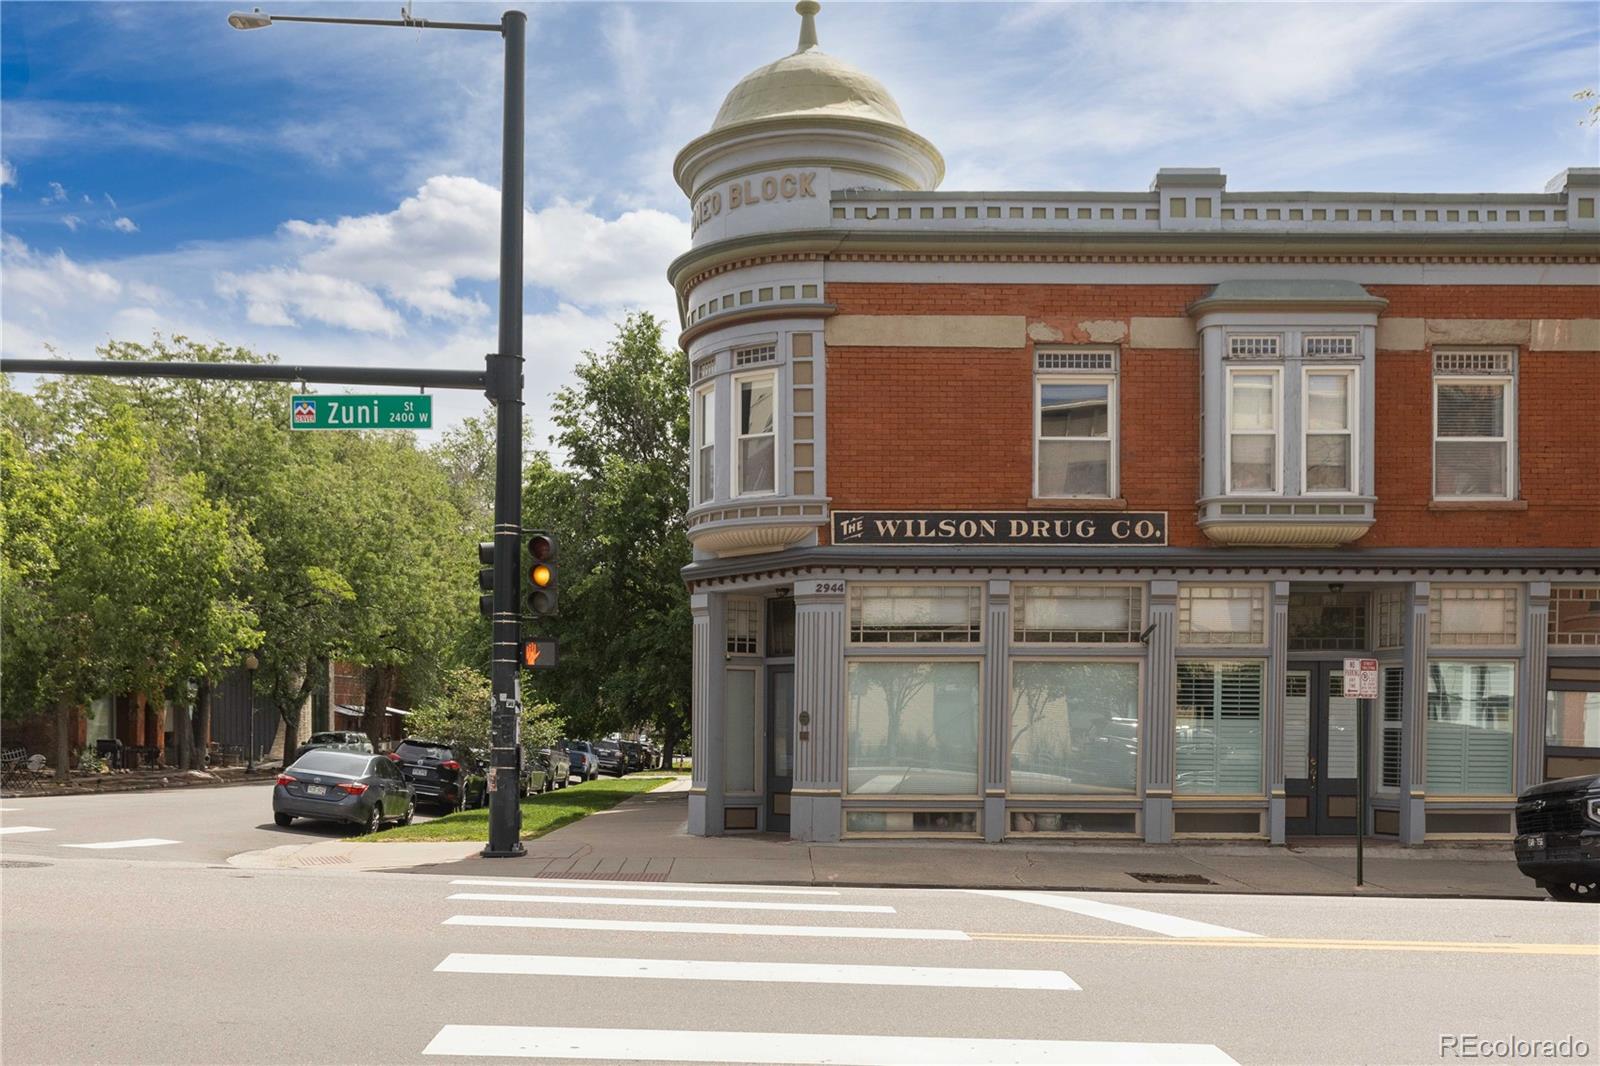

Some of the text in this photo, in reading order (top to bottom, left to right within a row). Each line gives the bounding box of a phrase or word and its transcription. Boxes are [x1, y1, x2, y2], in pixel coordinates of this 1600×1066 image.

[728, 171, 817, 210] BLOCK
[327, 399, 379, 424] Zuni
[389, 412, 429, 423] 2400 W
[840, 518, 1161, 539] THE WILSON DRUG CO.
[815, 583, 844, 593] 2944
